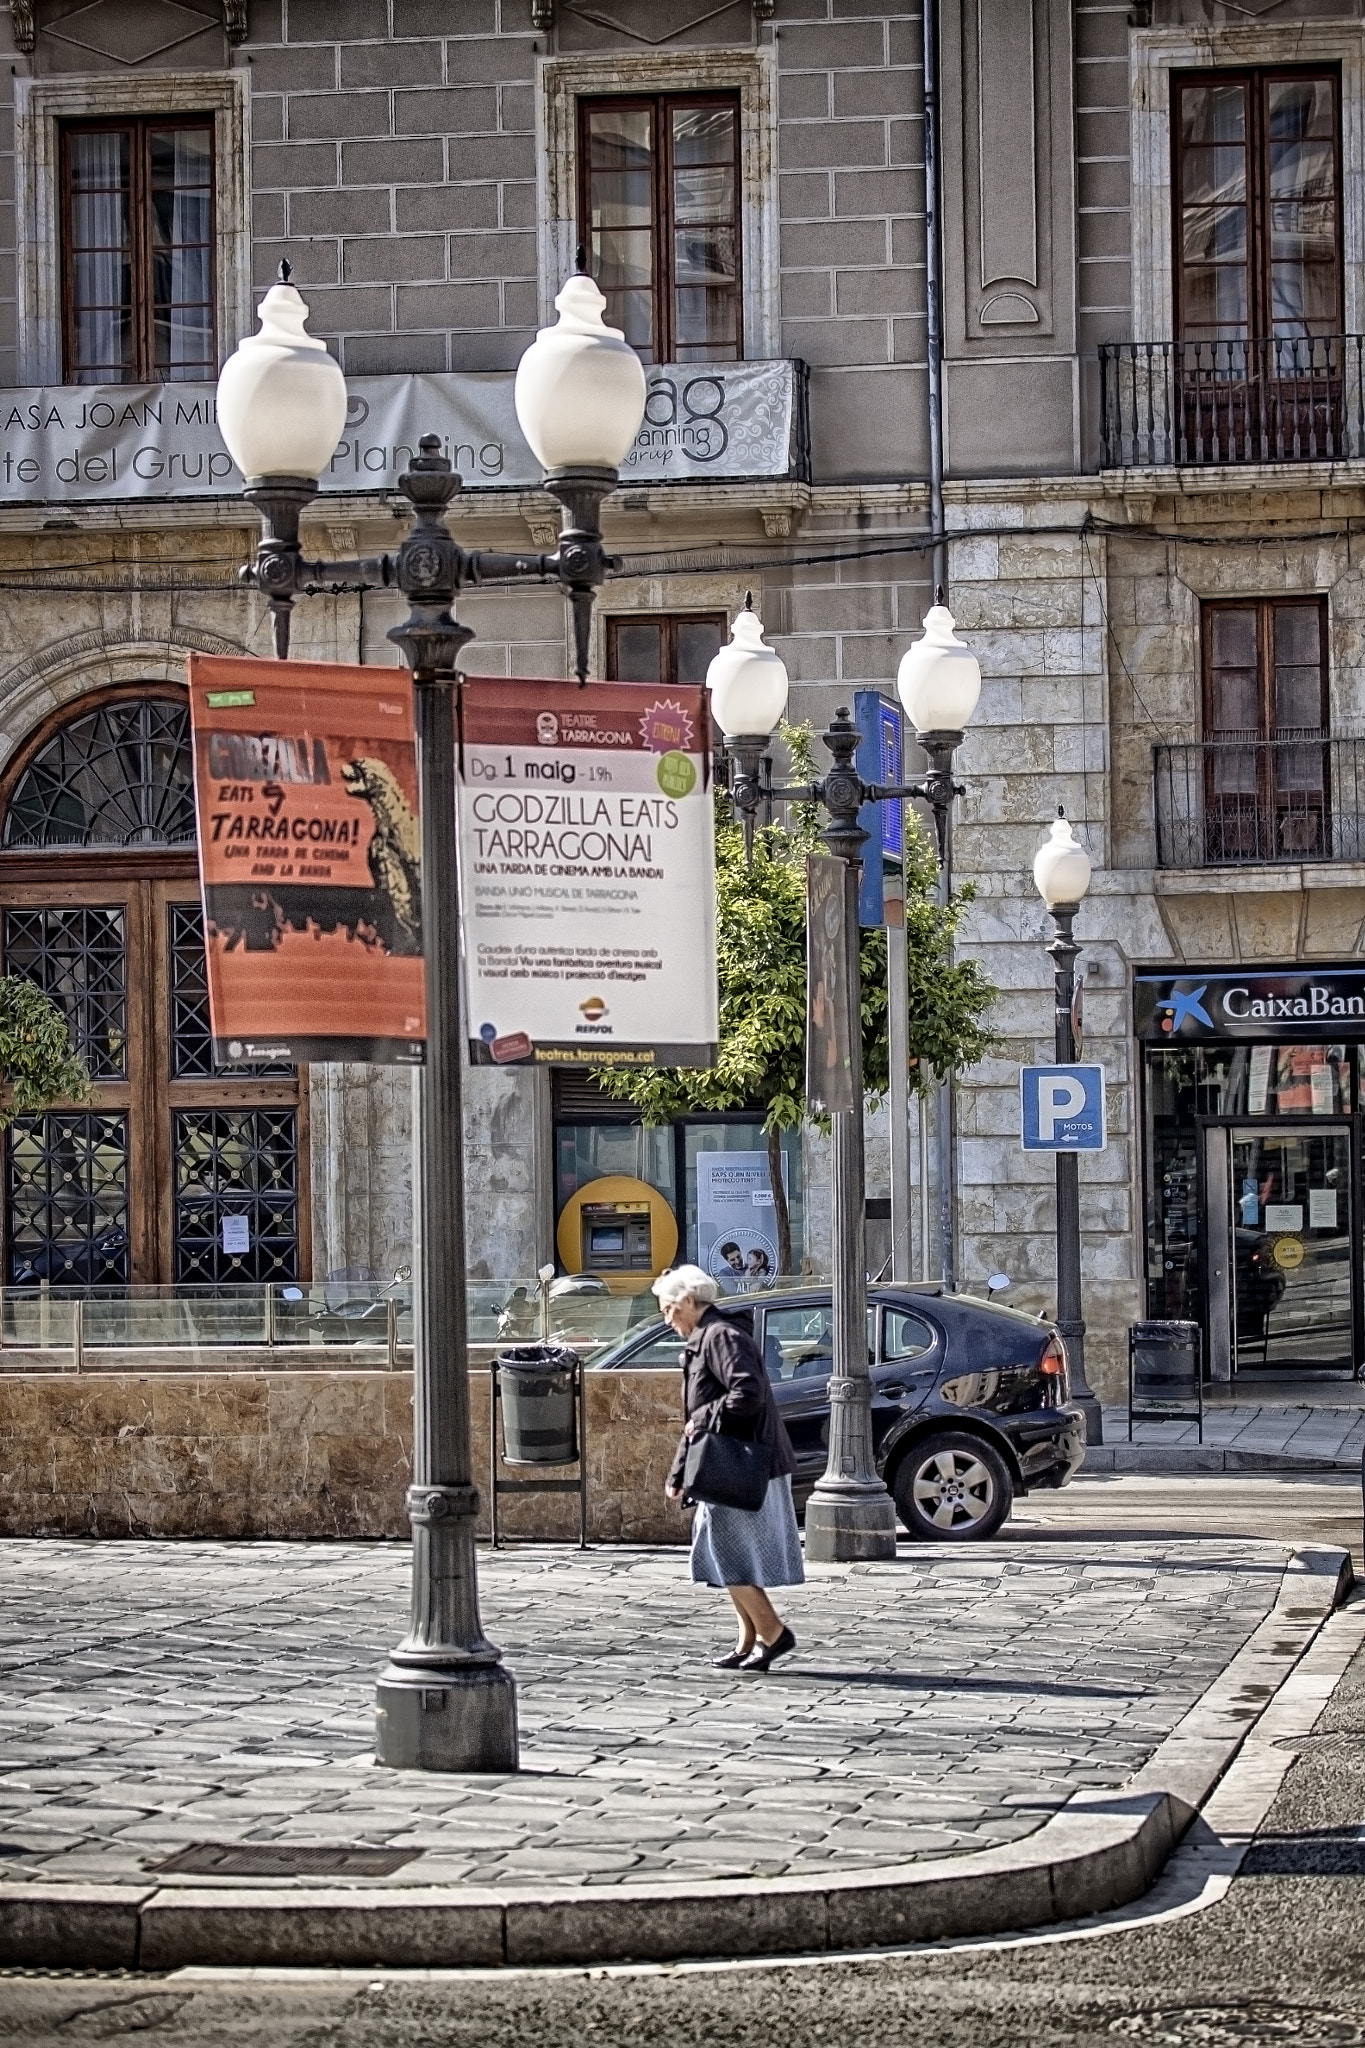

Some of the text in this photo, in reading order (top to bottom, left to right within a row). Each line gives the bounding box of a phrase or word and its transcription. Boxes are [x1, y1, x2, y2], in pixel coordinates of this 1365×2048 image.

[0, 400, 217, 430] ASA JOAN MI
[56, 448, 117, 483] del
[133, 447, 233, 485] Grup
[330, 436, 505, 477] Planing
[561, 713, 597, 728] TEATRE
[561, 728, 633, 745] TARRAGONA
[503, 756, 516, 779] 1
[525, 761, 576, 784] maig
[588, 766, 613, 783] 19h
[218, 785, 253, 802] EATS
[472, 793, 679, 830] GODZILLA EATS
[211, 813, 359, 847] TARRAGONA!
[473, 828, 652, 862] TARRAGONA!
[474, 862, 498, 875] UNA
[500, 862, 533, 876] TARDA
[534, 863, 548, 876] DE
[549, 864, 589, 877] CINEMA
[591, 865, 613, 878] AMB
[614, 866, 627, 878] LA
[586, 888, 638, 900] TARRAGONA
[1222, 986, 1365, 1018] CaixaBan
[575, 1023, 613, 1035] REPSOL
[1038, 1075, 1086, 1141] P
[1063, 1122, 1093, 1131] MOTOS
